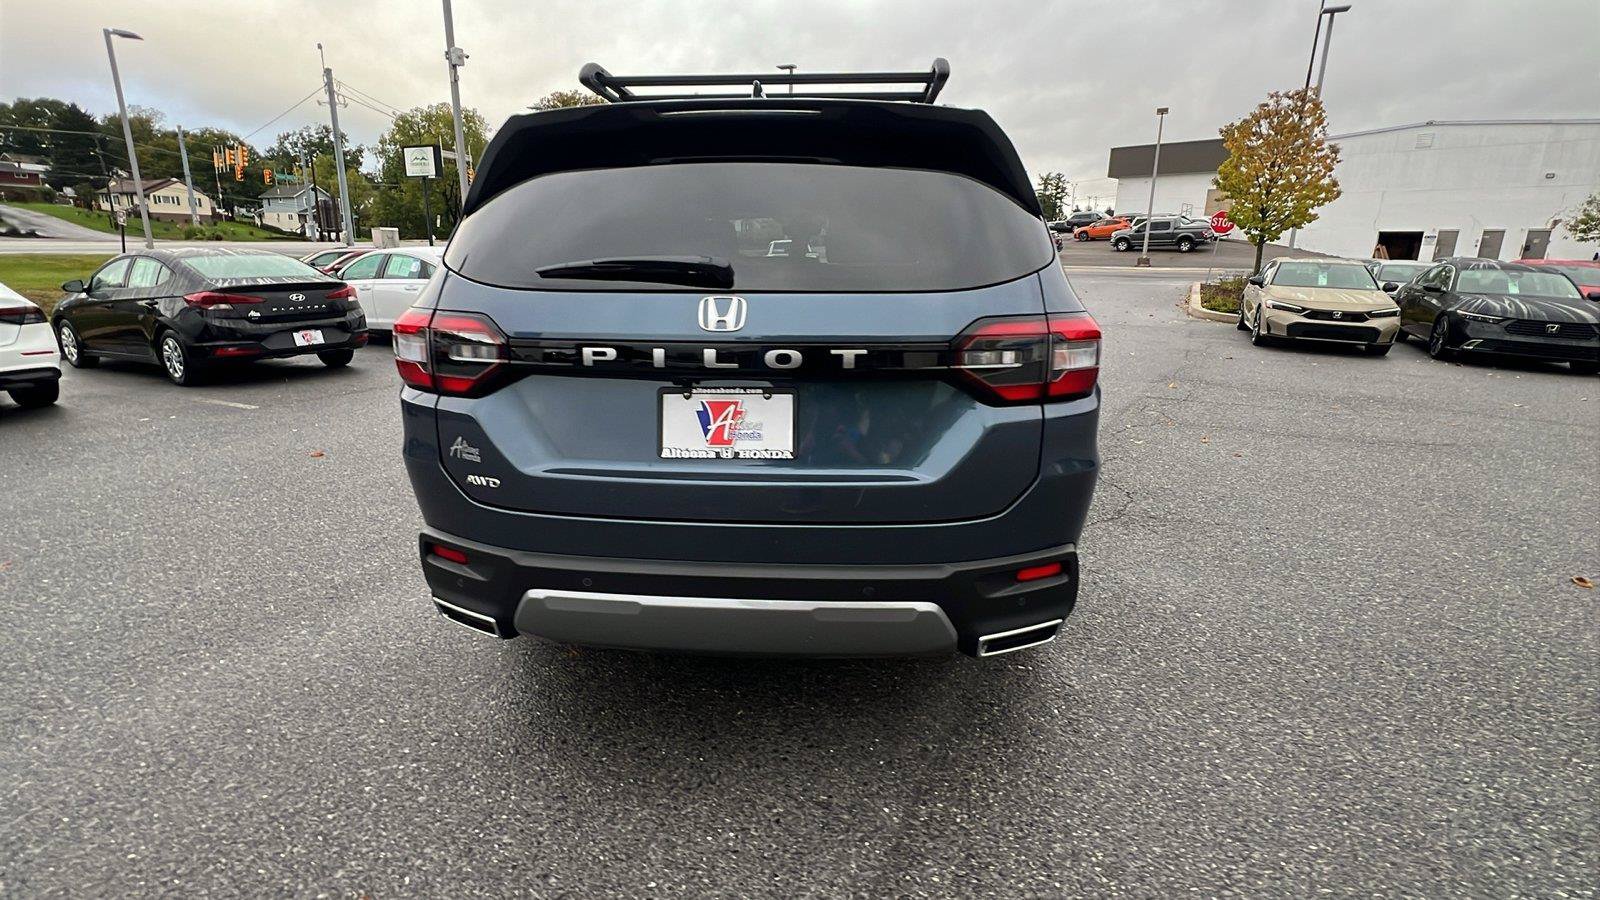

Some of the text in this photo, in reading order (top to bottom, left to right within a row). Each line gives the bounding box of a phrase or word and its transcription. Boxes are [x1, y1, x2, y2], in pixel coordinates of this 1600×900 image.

[582, 346, 868, 370] PILOT
[661, 447, 794, 460] Altoona HONDA
[466, 474, 501, 488] AWD
